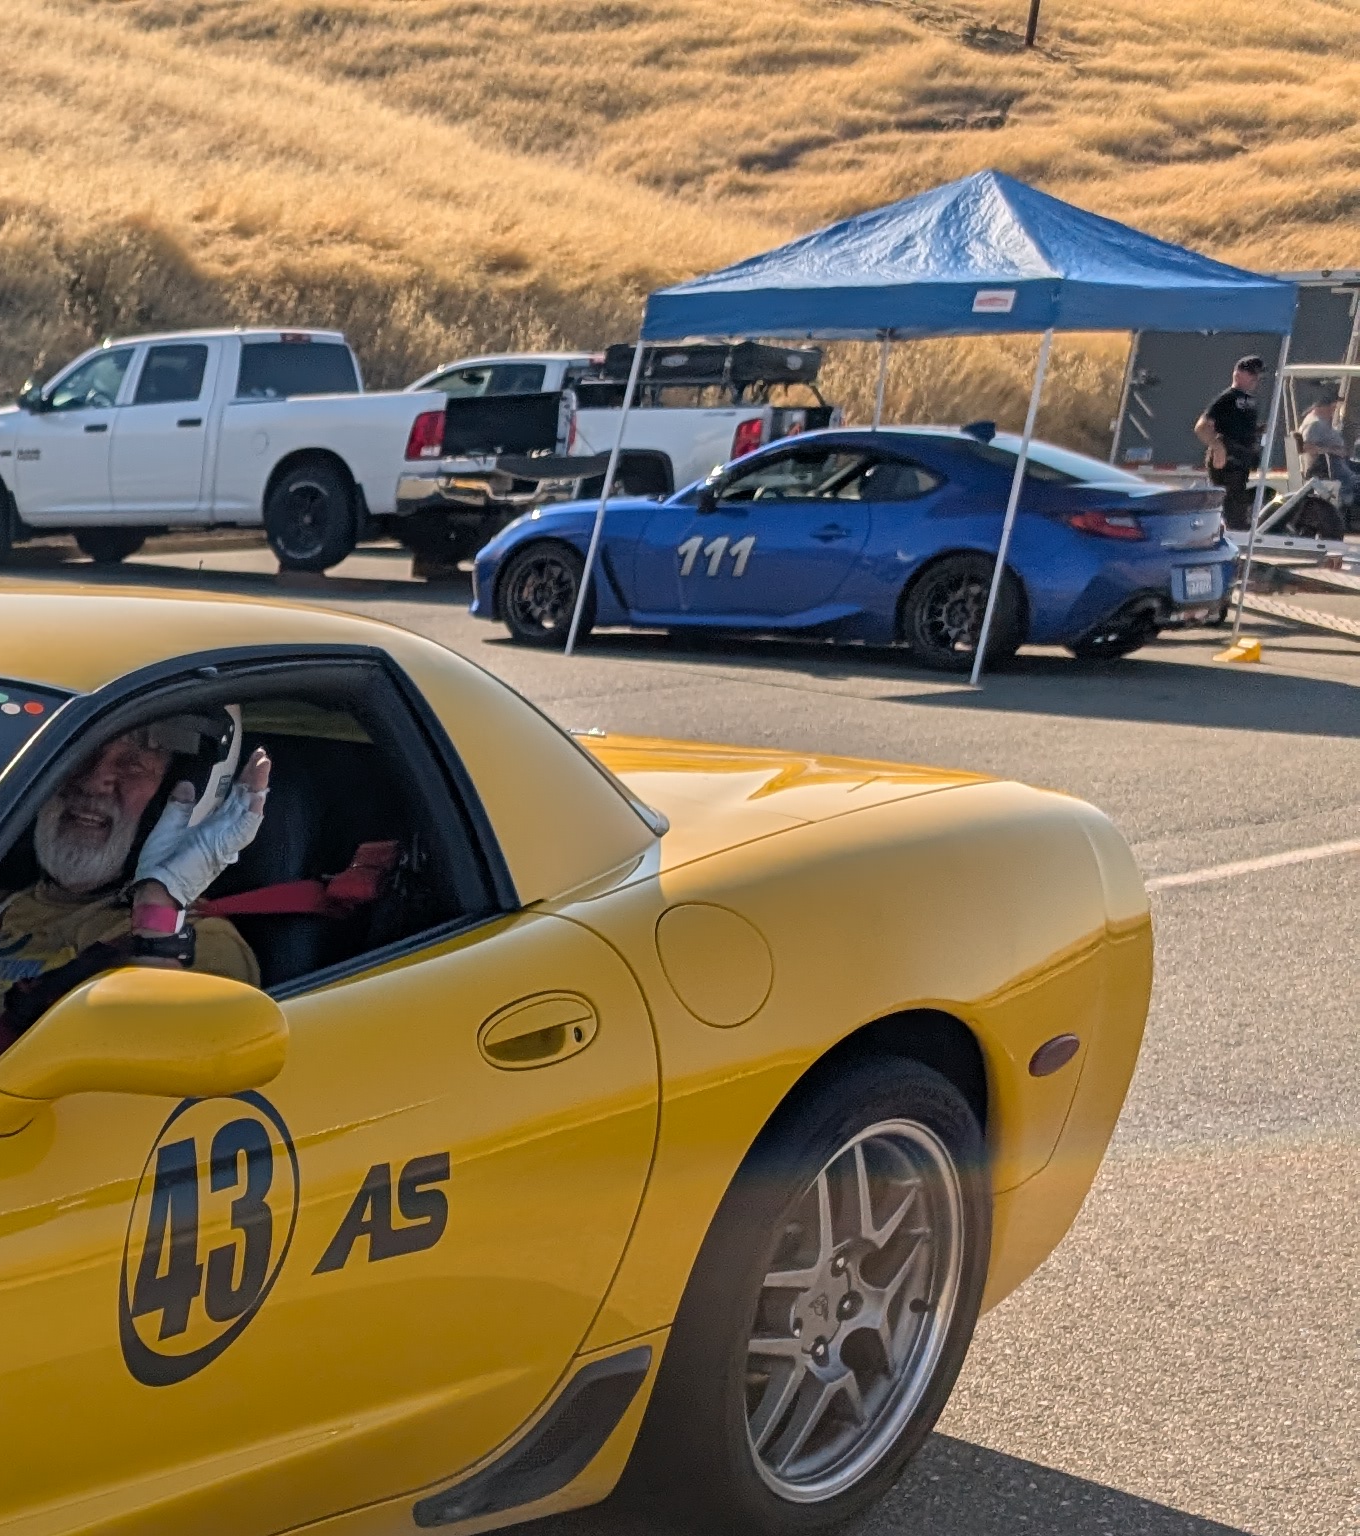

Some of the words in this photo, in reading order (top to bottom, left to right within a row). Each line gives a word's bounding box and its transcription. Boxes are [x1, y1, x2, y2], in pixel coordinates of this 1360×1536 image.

[677, 535, 756, 577] 111
[131, 1118, 274, 1341] 43
[311, 1151, 451, 1276] AS
